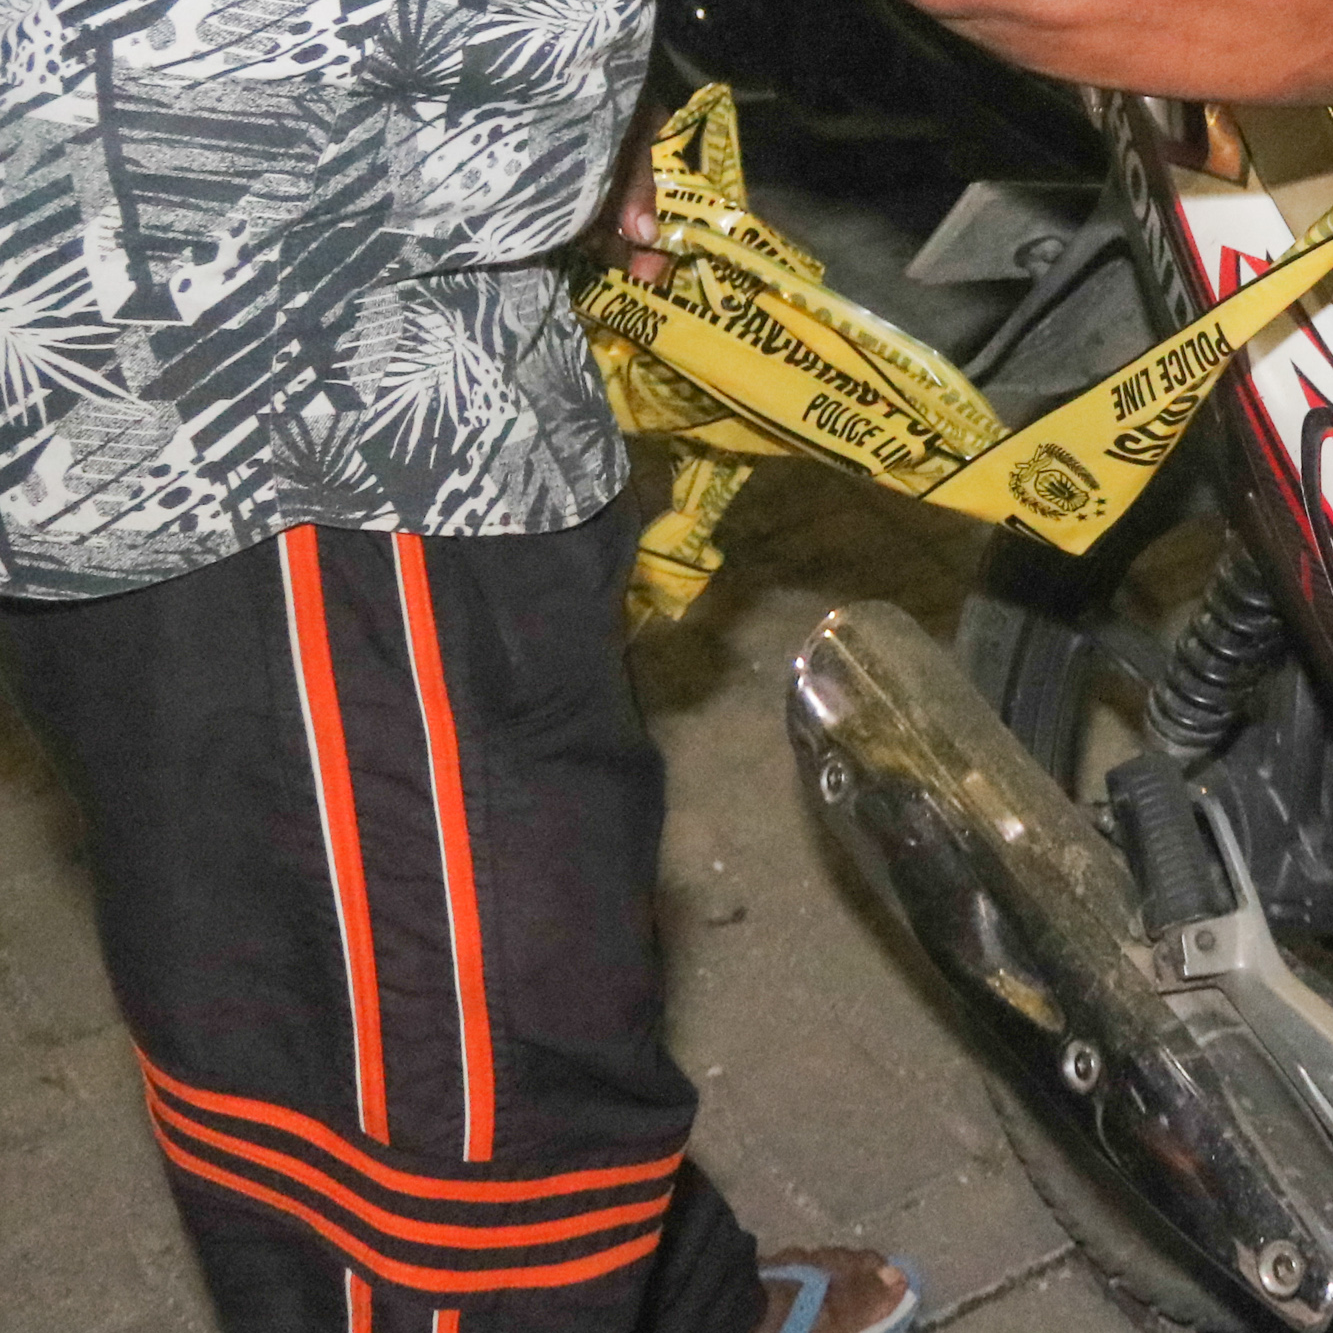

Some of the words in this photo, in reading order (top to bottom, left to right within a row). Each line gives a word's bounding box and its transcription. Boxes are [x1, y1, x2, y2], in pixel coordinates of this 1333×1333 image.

[600, 288, 668, 347] CROSS
[1155, 321, 1236, 393] POLICE
[801, 392, 886, 449] POLICE
[1110, 366, 1157, 422] LINE
